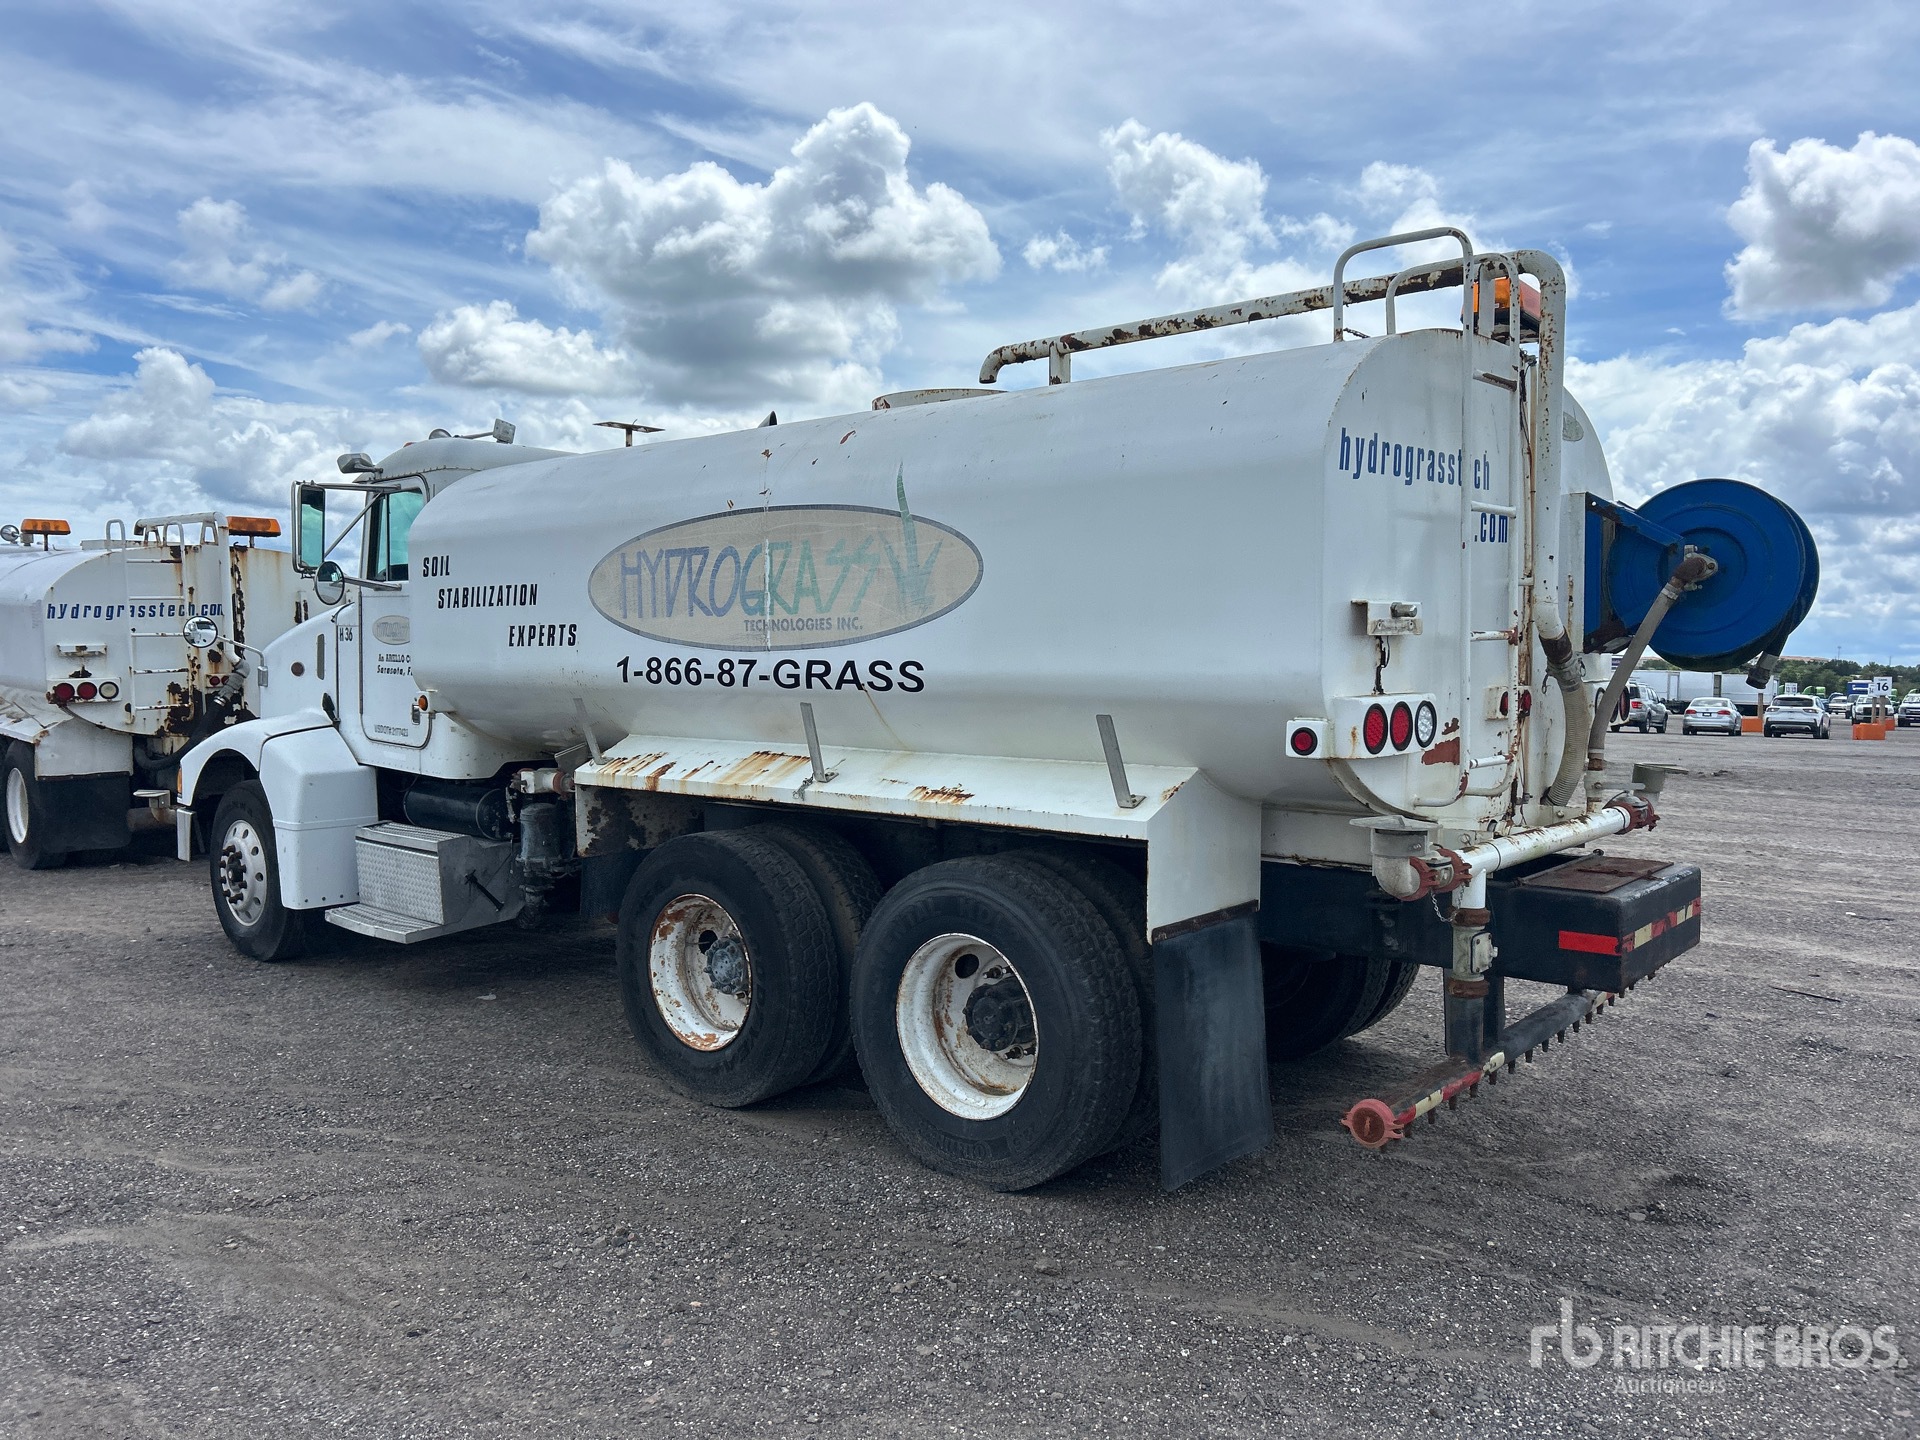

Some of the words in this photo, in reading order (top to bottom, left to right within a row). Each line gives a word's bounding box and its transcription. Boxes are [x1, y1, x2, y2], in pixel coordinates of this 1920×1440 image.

[1339, 427, 1490, 490] hydrograsstch
[1474, 512, 1508, 543] .com
[423, 555, 450, 577] SOIL
[438, 583, 538, 609] STABILIZATION
[345, 627, 353, 641] 36
[508, 624, 577, 647] EXPERTS
[744, 617, 833, 632] TECHNOLOGIES
[837, 616, 863, 630] INC.
[616, 655, 925, 693] 1-866-87-GRASS
[1876, 682, 1889, 692] 16
